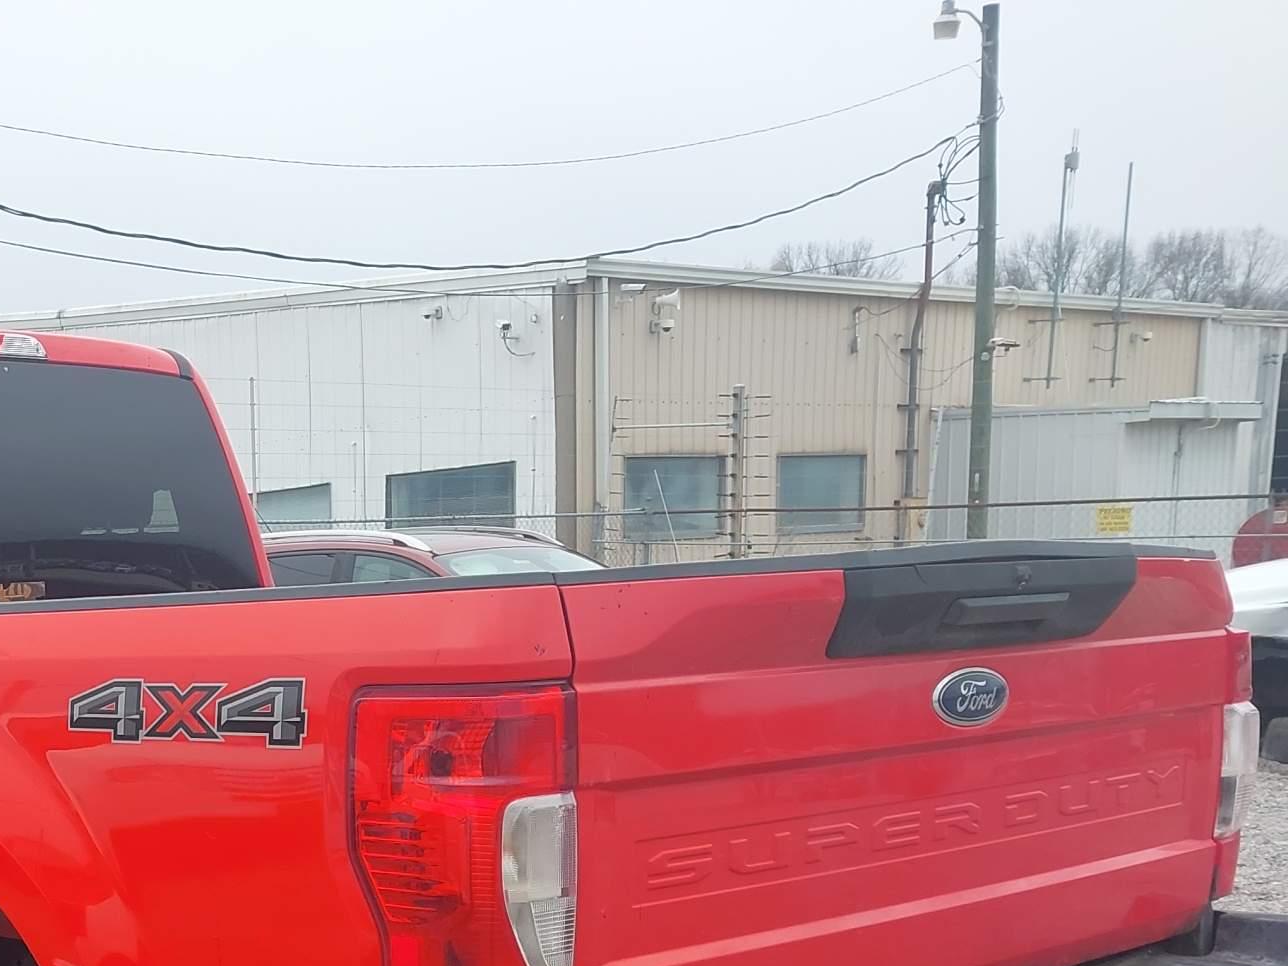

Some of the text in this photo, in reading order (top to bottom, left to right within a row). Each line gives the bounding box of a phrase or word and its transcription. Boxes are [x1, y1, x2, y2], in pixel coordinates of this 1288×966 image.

[956, 680, 998, 712] Ford
[646, 764, 1182, 890] SUPER DUTY
